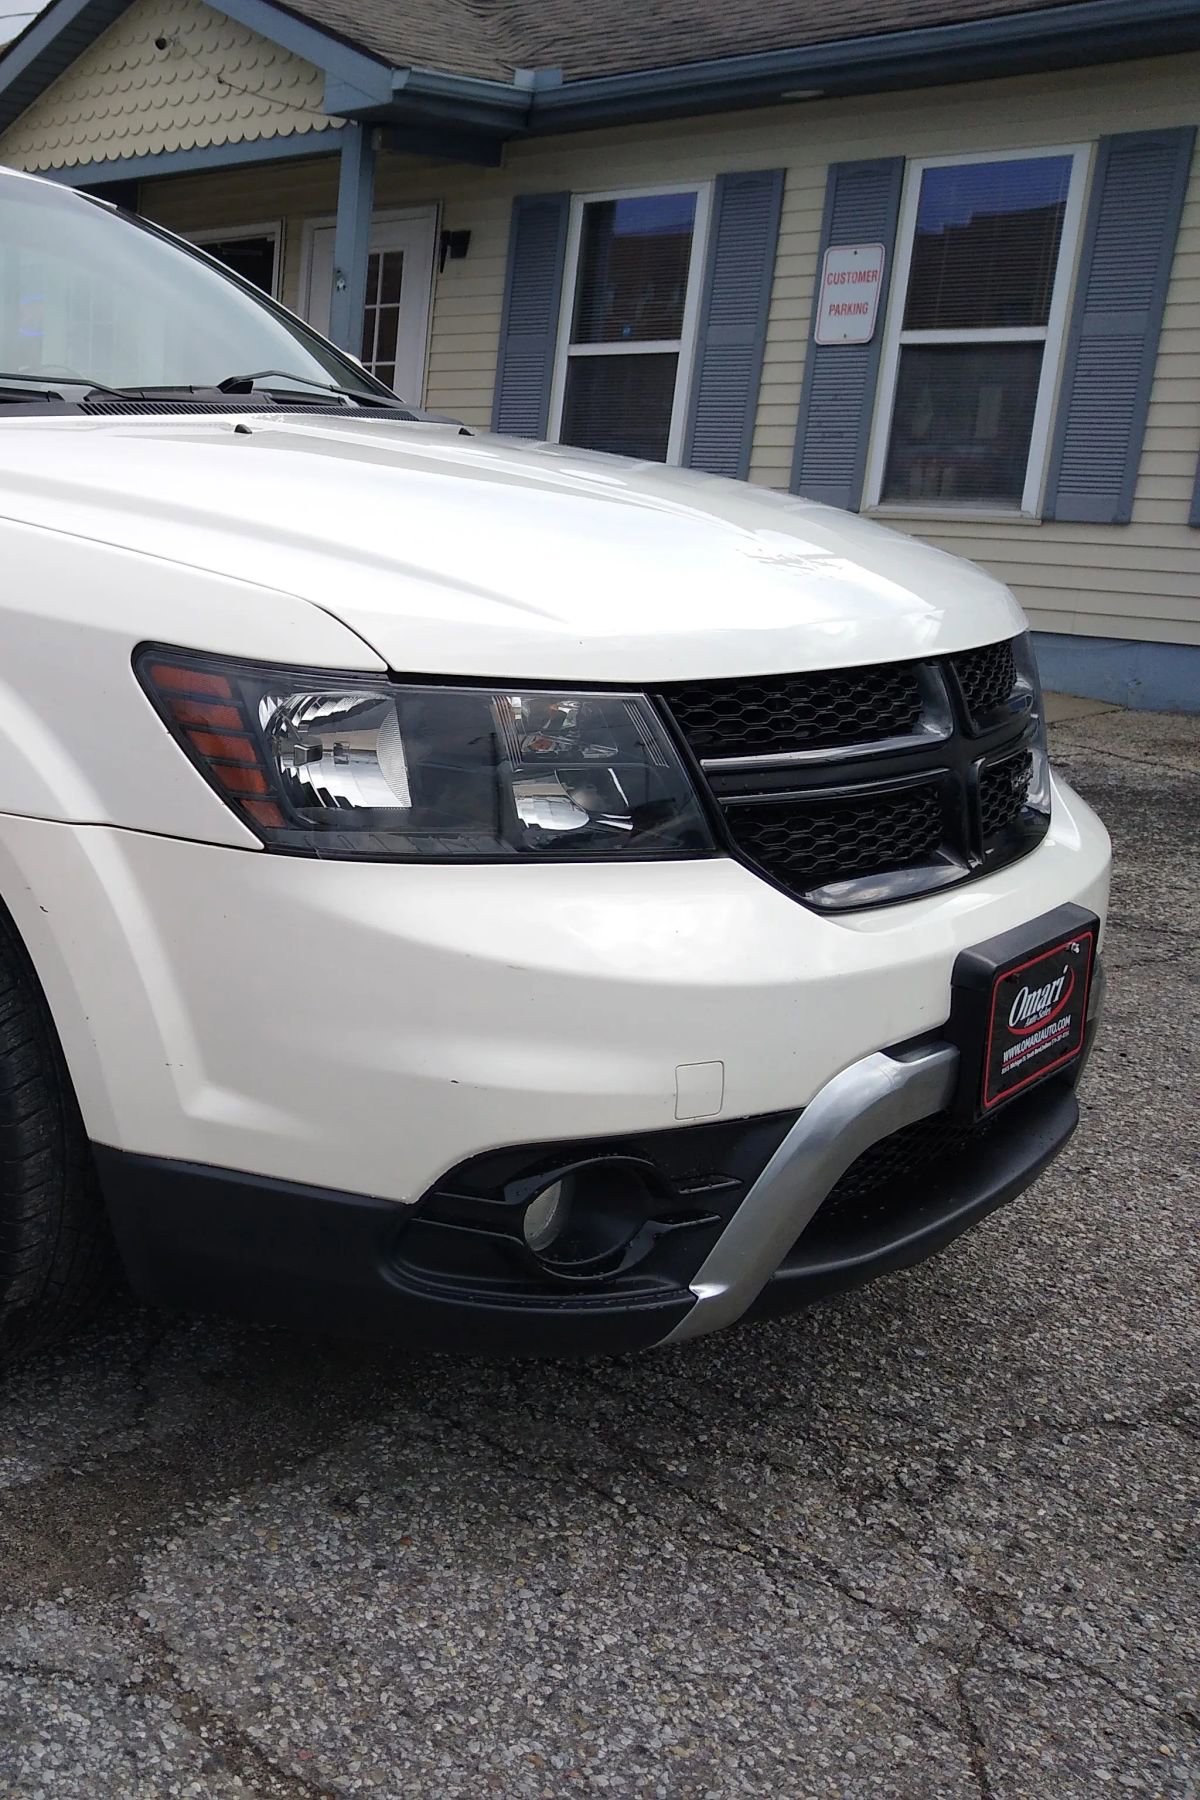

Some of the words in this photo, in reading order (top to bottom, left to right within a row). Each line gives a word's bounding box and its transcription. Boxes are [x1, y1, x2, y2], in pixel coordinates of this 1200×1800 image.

[826, 269, 879, 286] CUSTOMER
[828, 302, 869, 316] PARKING
[1008, 964, 1069, 1028] Omari
